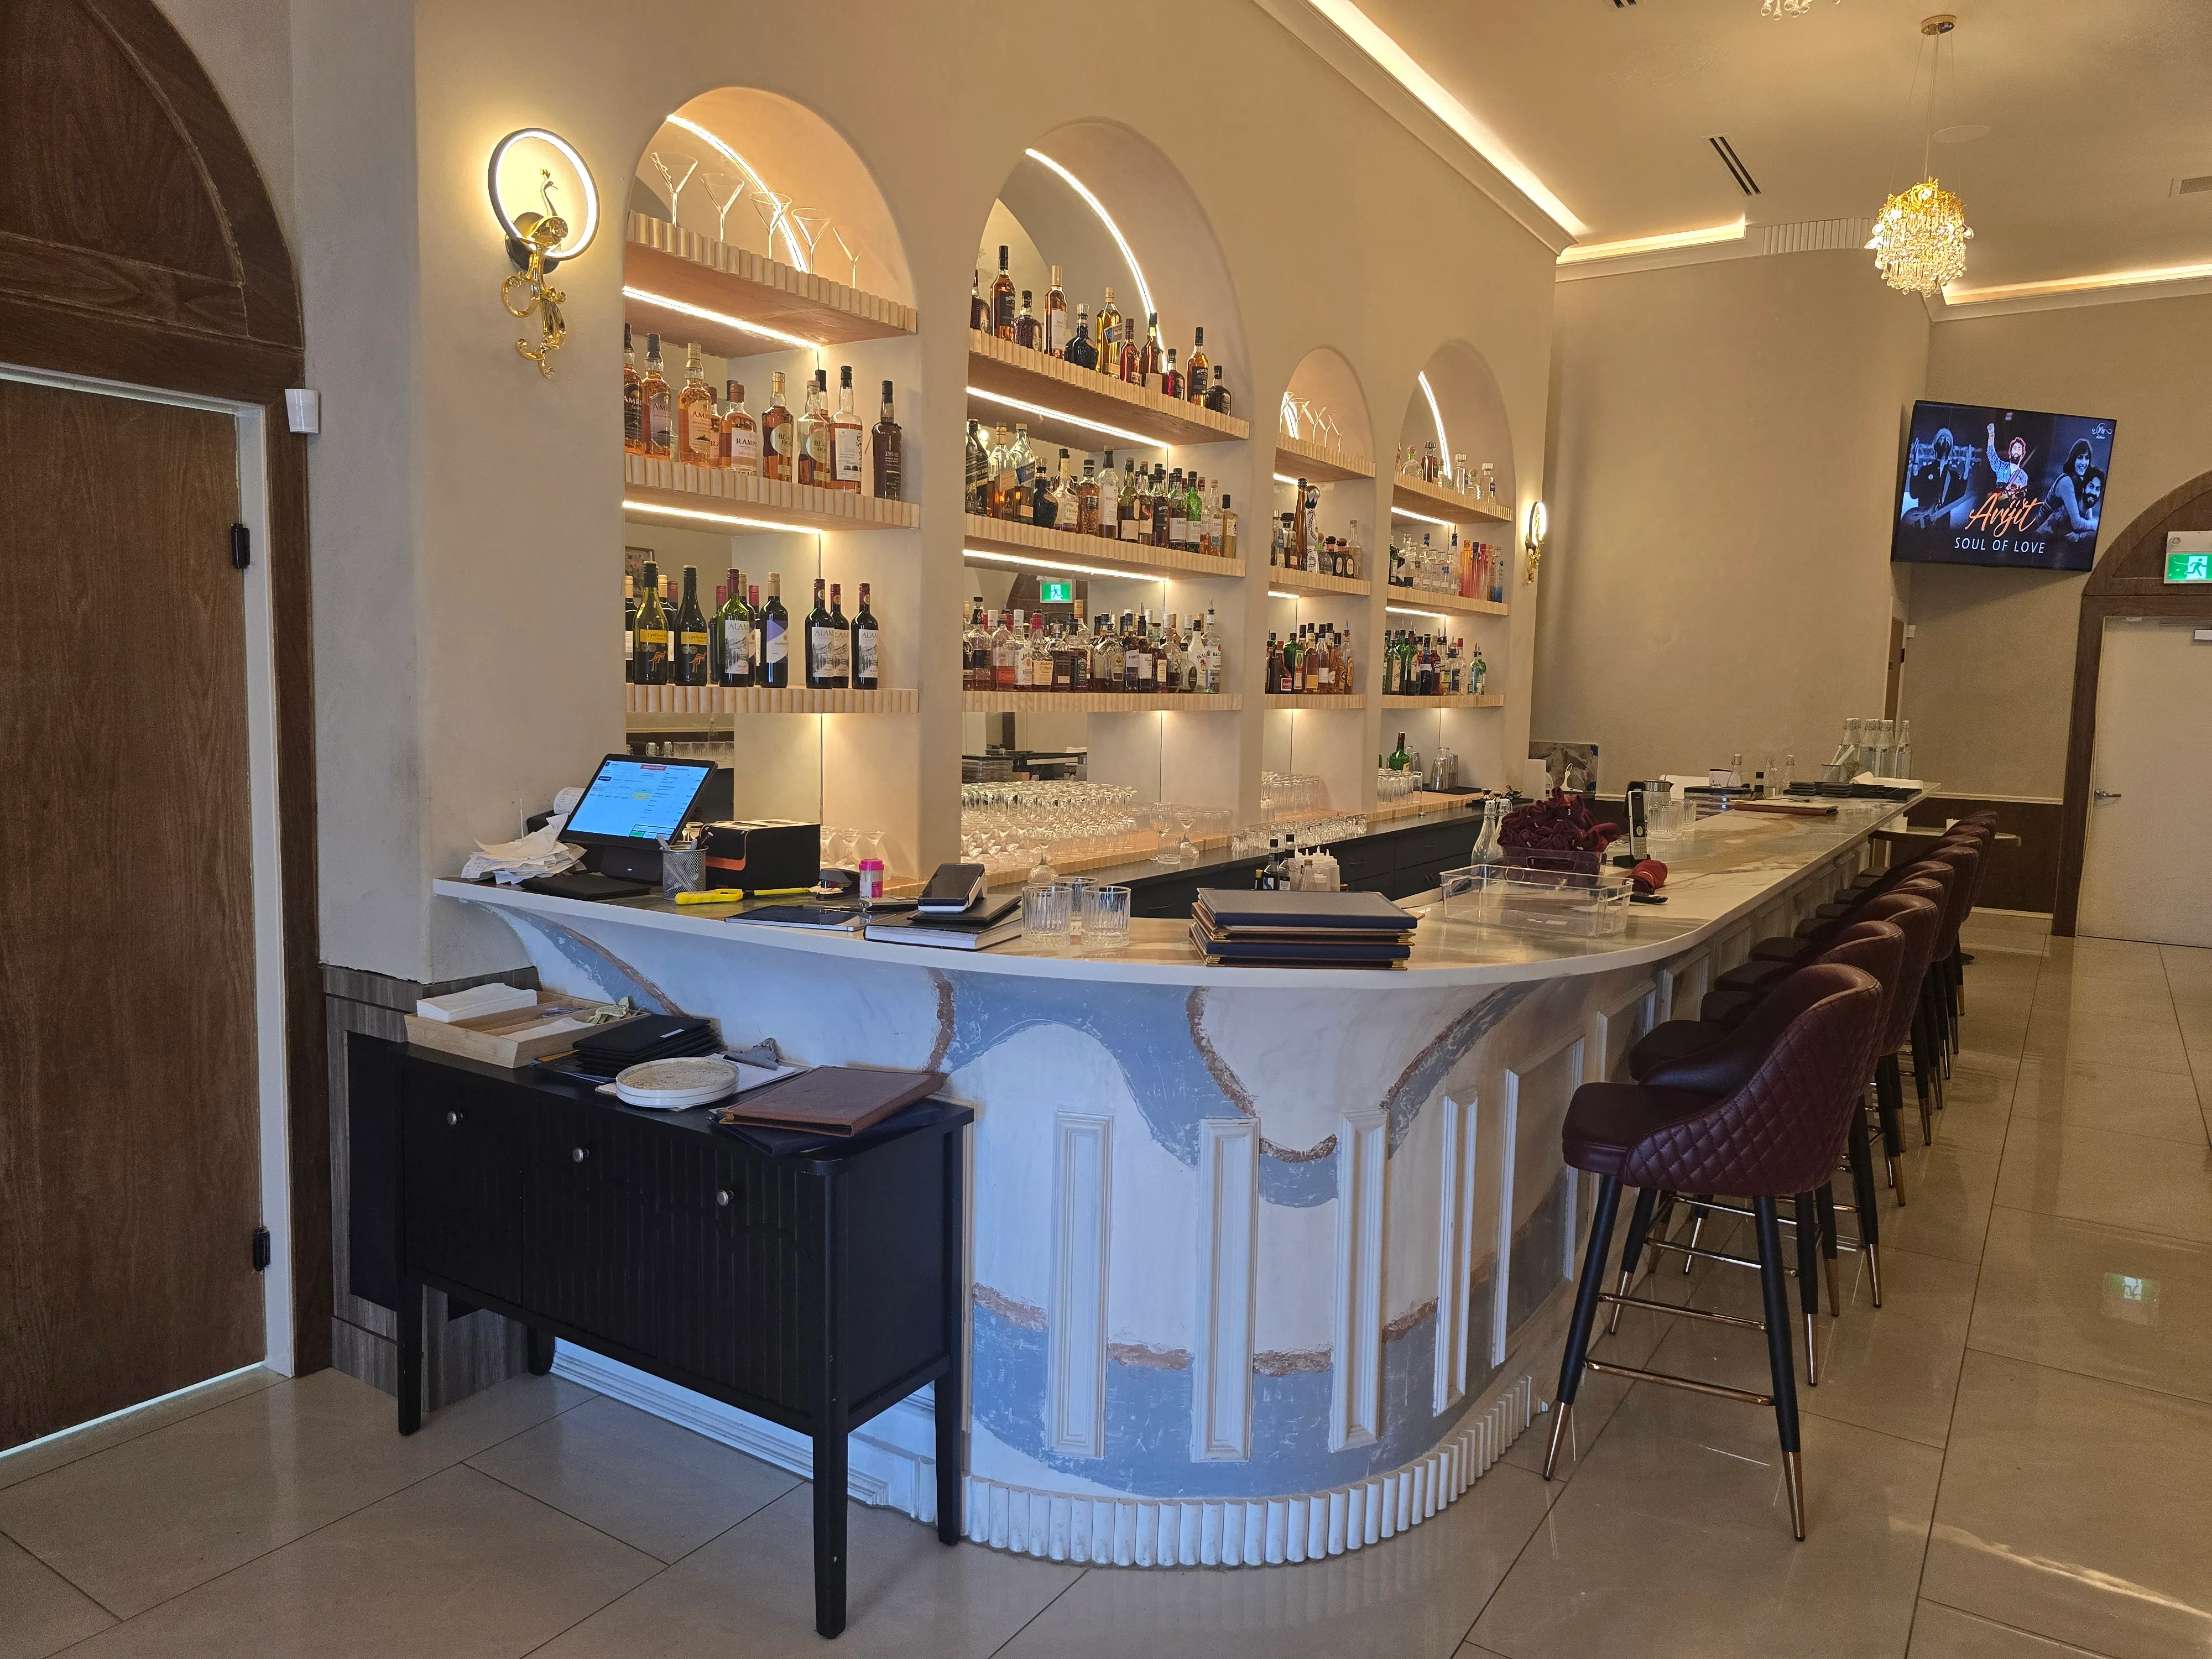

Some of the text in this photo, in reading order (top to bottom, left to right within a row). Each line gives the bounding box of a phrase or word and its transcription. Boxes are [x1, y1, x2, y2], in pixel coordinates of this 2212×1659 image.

[1954, 537, 2046, 554] SOUL OF LOVE
